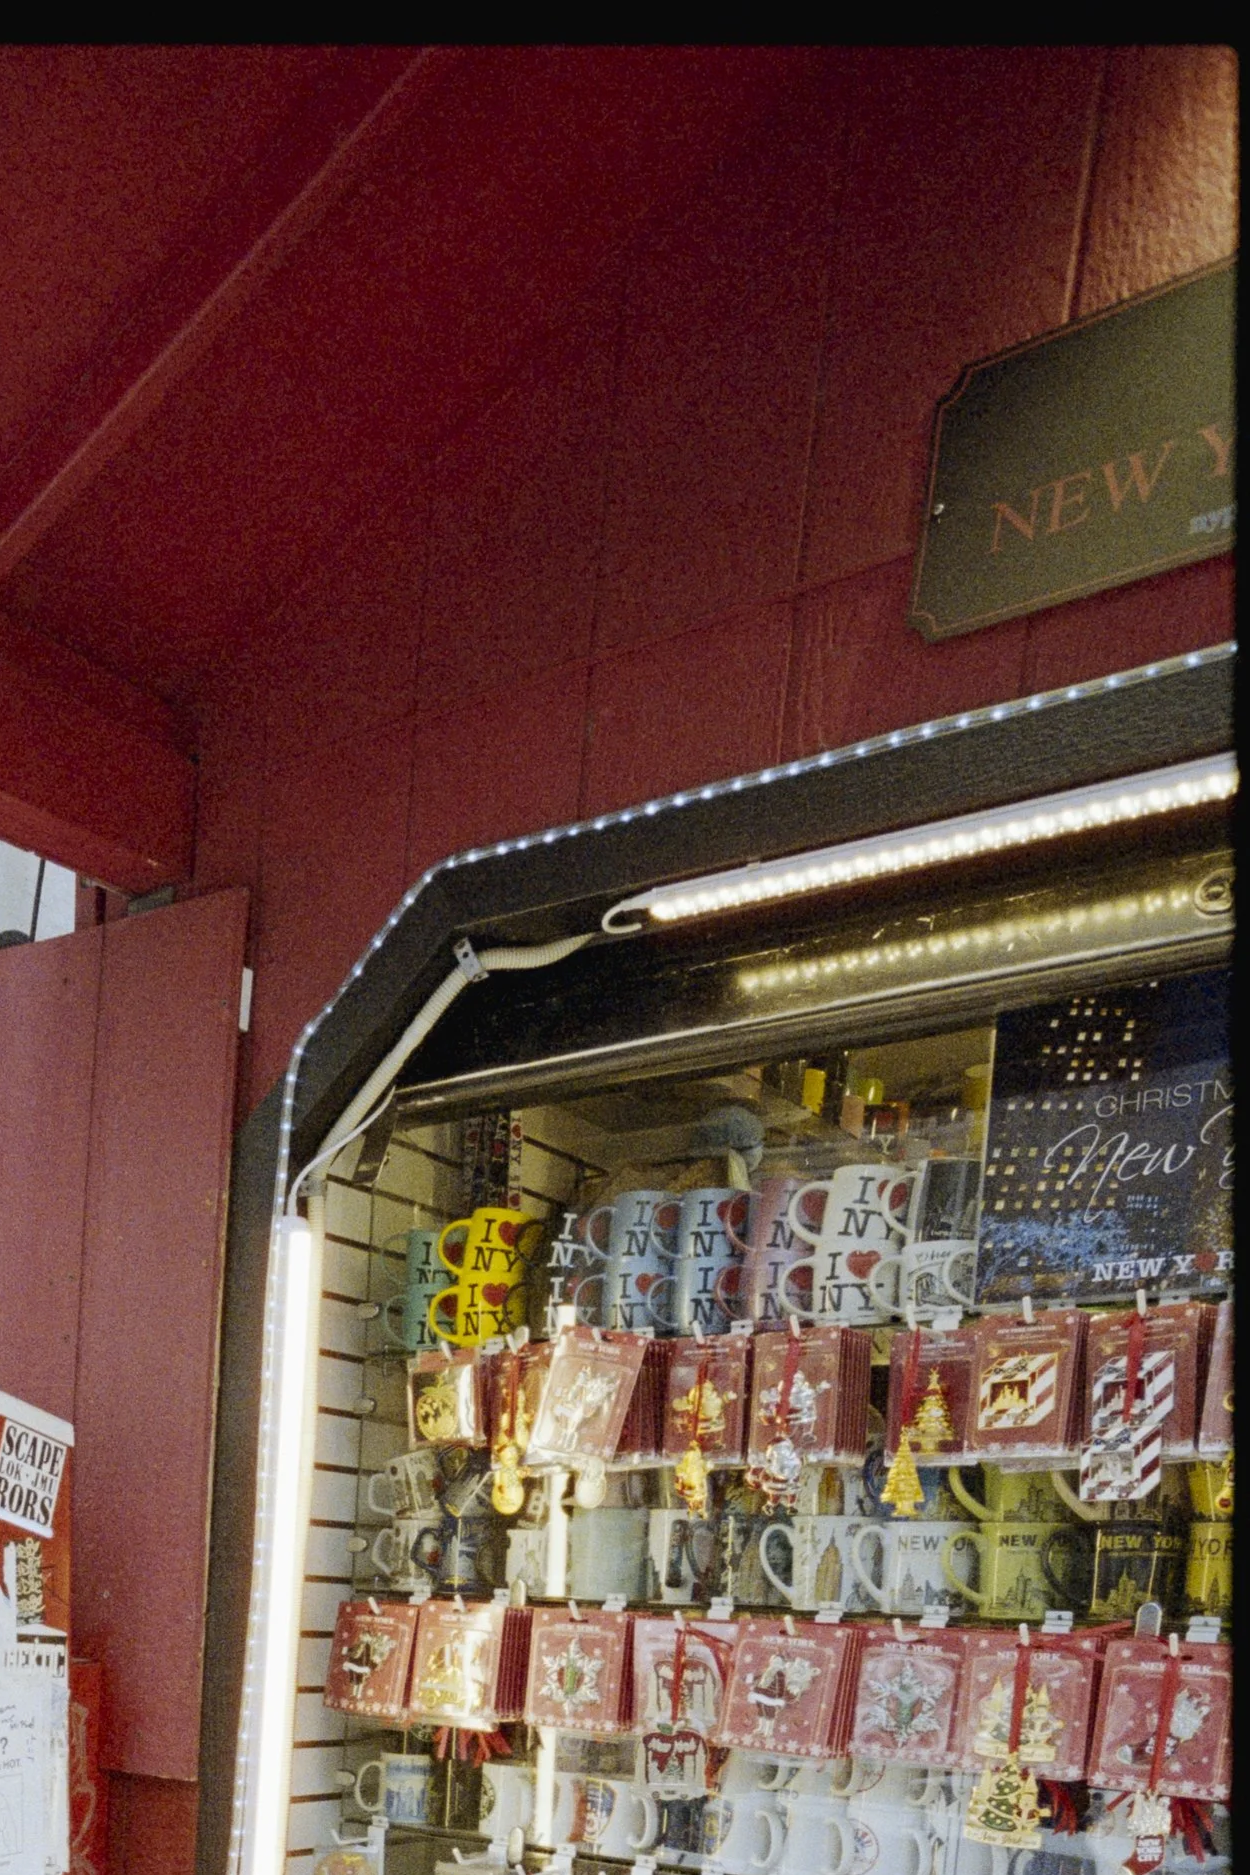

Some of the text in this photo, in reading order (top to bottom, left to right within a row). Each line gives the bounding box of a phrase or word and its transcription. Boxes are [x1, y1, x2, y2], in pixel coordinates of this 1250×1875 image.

[987, 440, 1173, 556] NEW
[1043, 1122, 1196, 1224] New
[853, 1175, 876, 1205] I
[558, 1213, 577, 1240] I
[697, 1200, 712, 1227] I
[480, 1218, 493, 1243] I
[473, 1246, 521, 1273] NY
[826, 1251, 844, 1281] I
[1092, 1256, 1166, 1283] NEW
[619, 1272, 632, 1300] I
[698, 1266, 714, 1294] I
[468, 1284, 479, 1308] I
[819, 1283, 885, 1315] NY
[462, 1310, 514, 1337] NY
[2, 1424, 63, 1479] SCAPE
[897, 1535, 938, 1551] NEW
[1000, 1534, 1037, 1547] NEW
[1101, 1535, 1143, 1550] NEW
[1180, 1664, 1212, 1675] ORK
